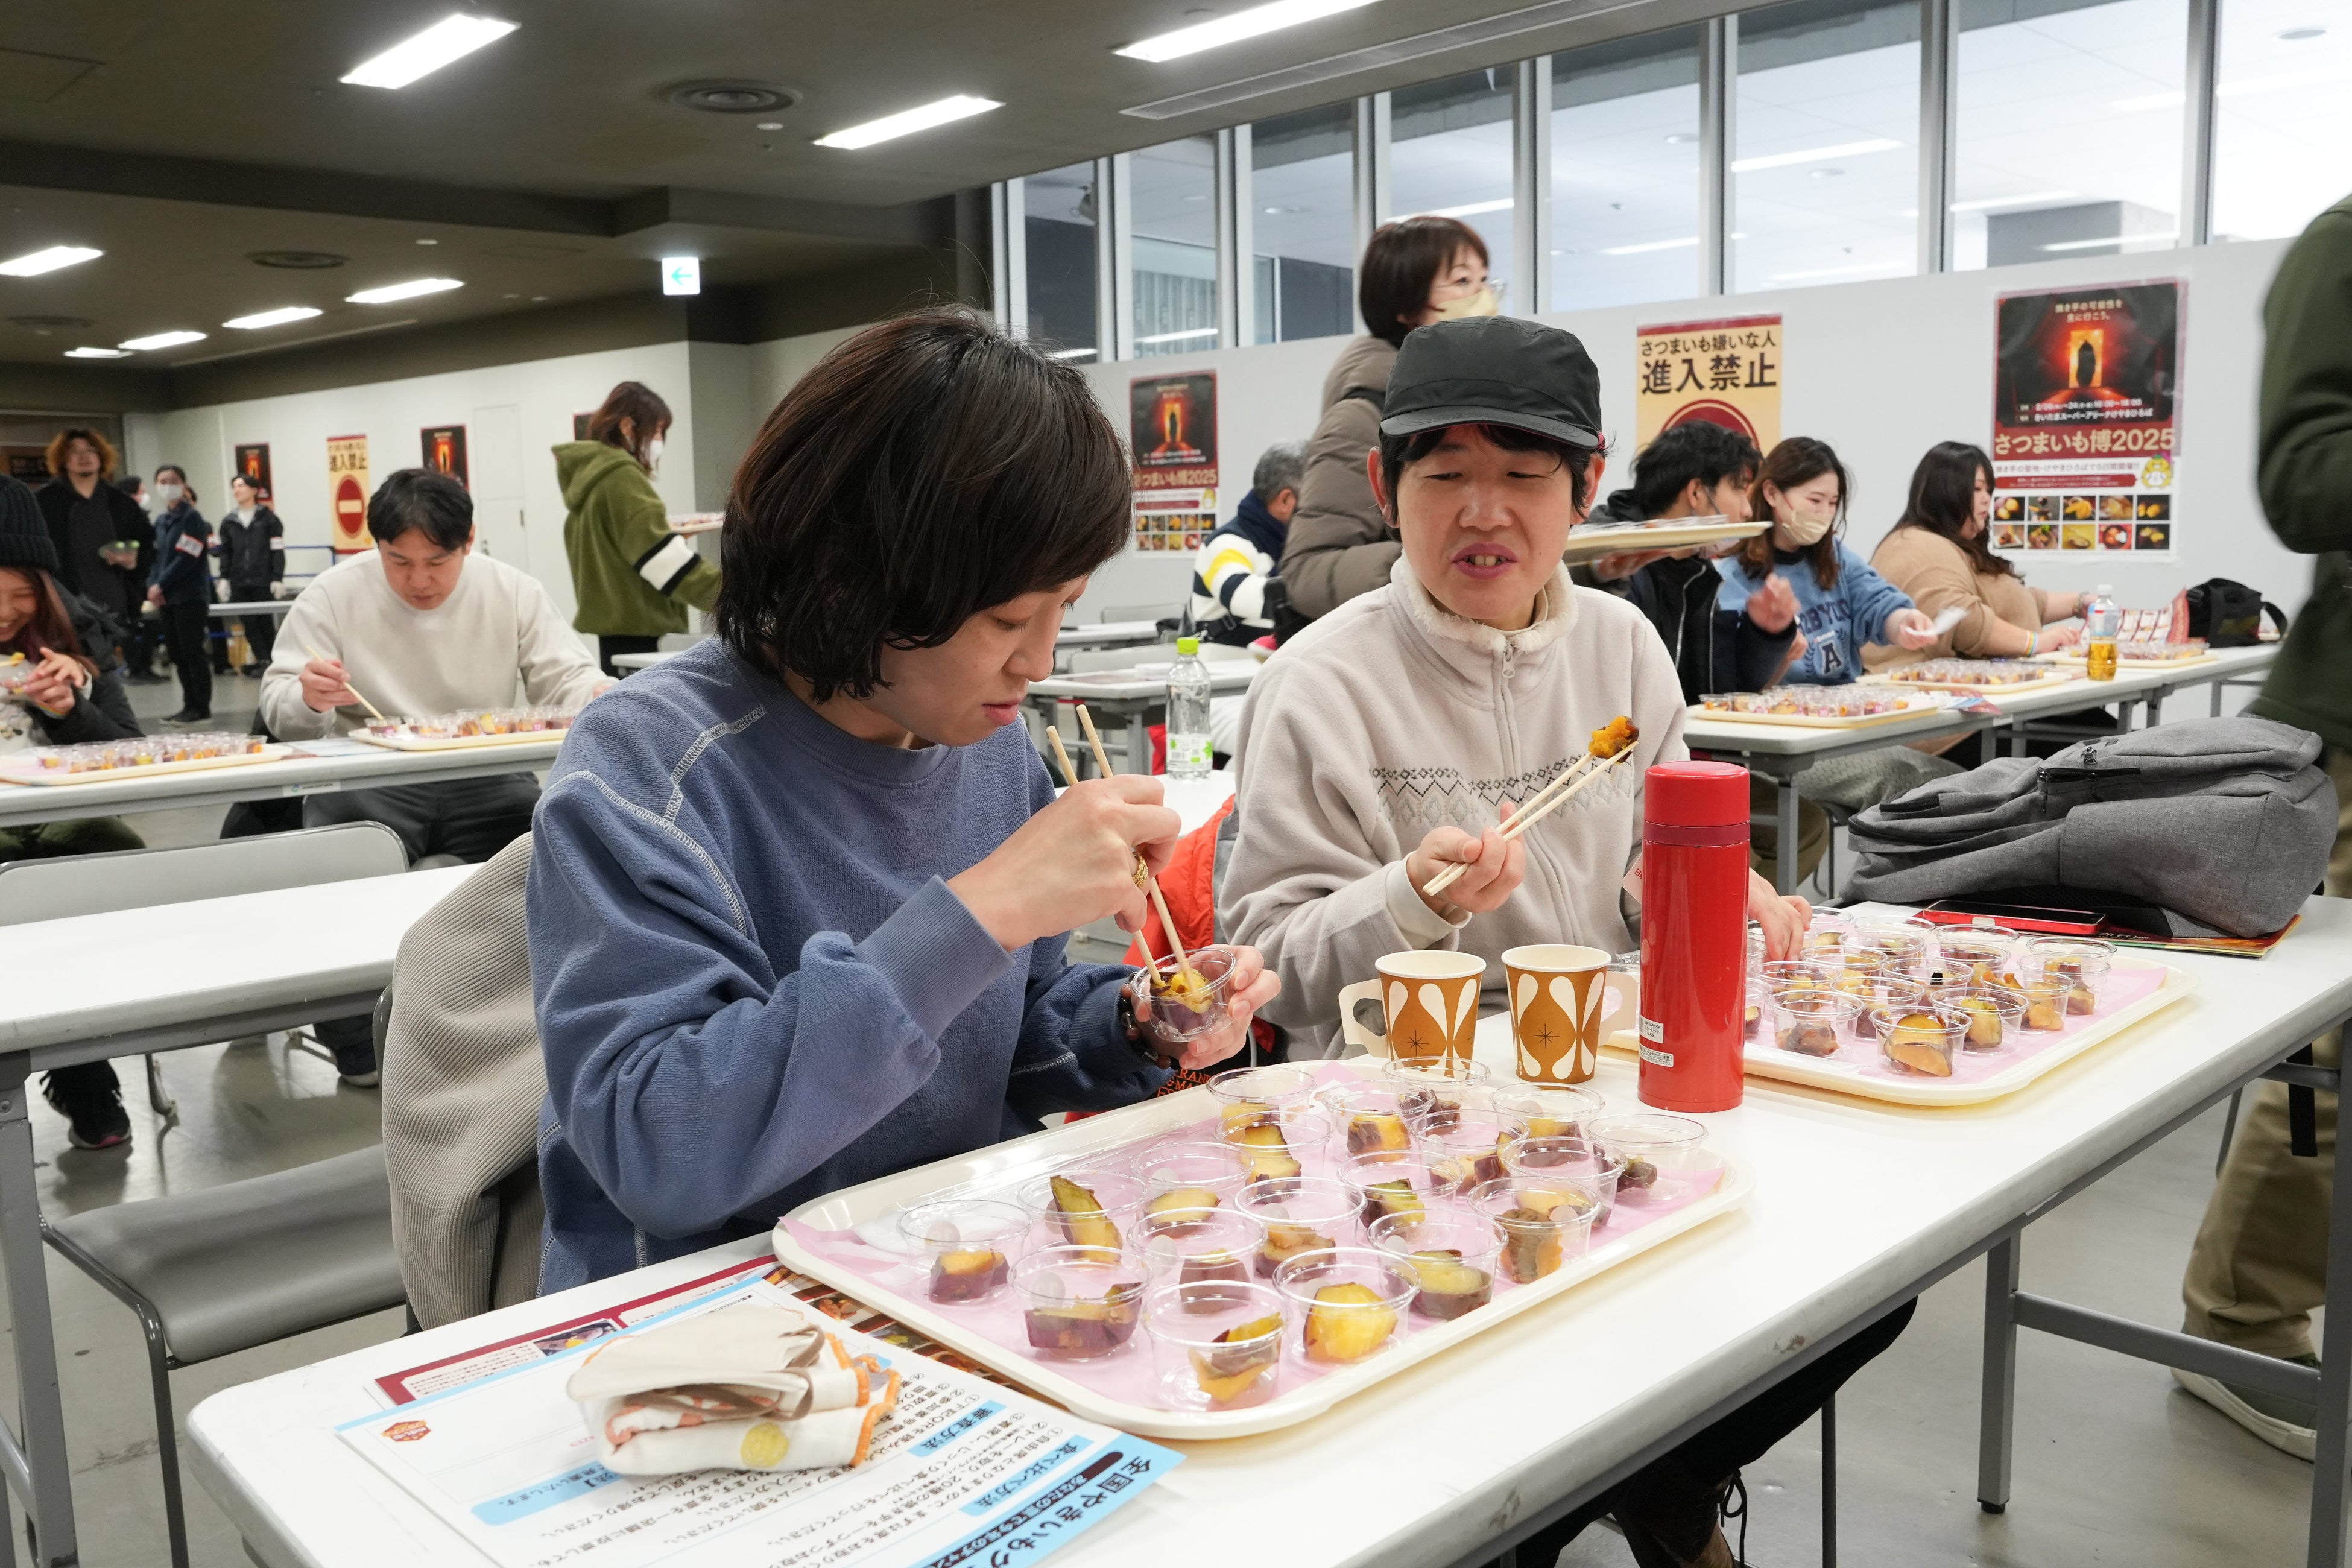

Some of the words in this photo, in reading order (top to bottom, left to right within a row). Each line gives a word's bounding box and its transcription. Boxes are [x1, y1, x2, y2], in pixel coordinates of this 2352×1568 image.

[1641, 330, 1775, 356] さつまいも嫌いな人
[1642, 352, 1776, 395] 進入禁止
[1995, 428, 2175, 455] さつまいも博2025
[1822, 643, 1841, 674] A
[918, 1408, 996, 1449] 審査方法
[973, 1442, 1081, 1507] 食べ比べ方法
